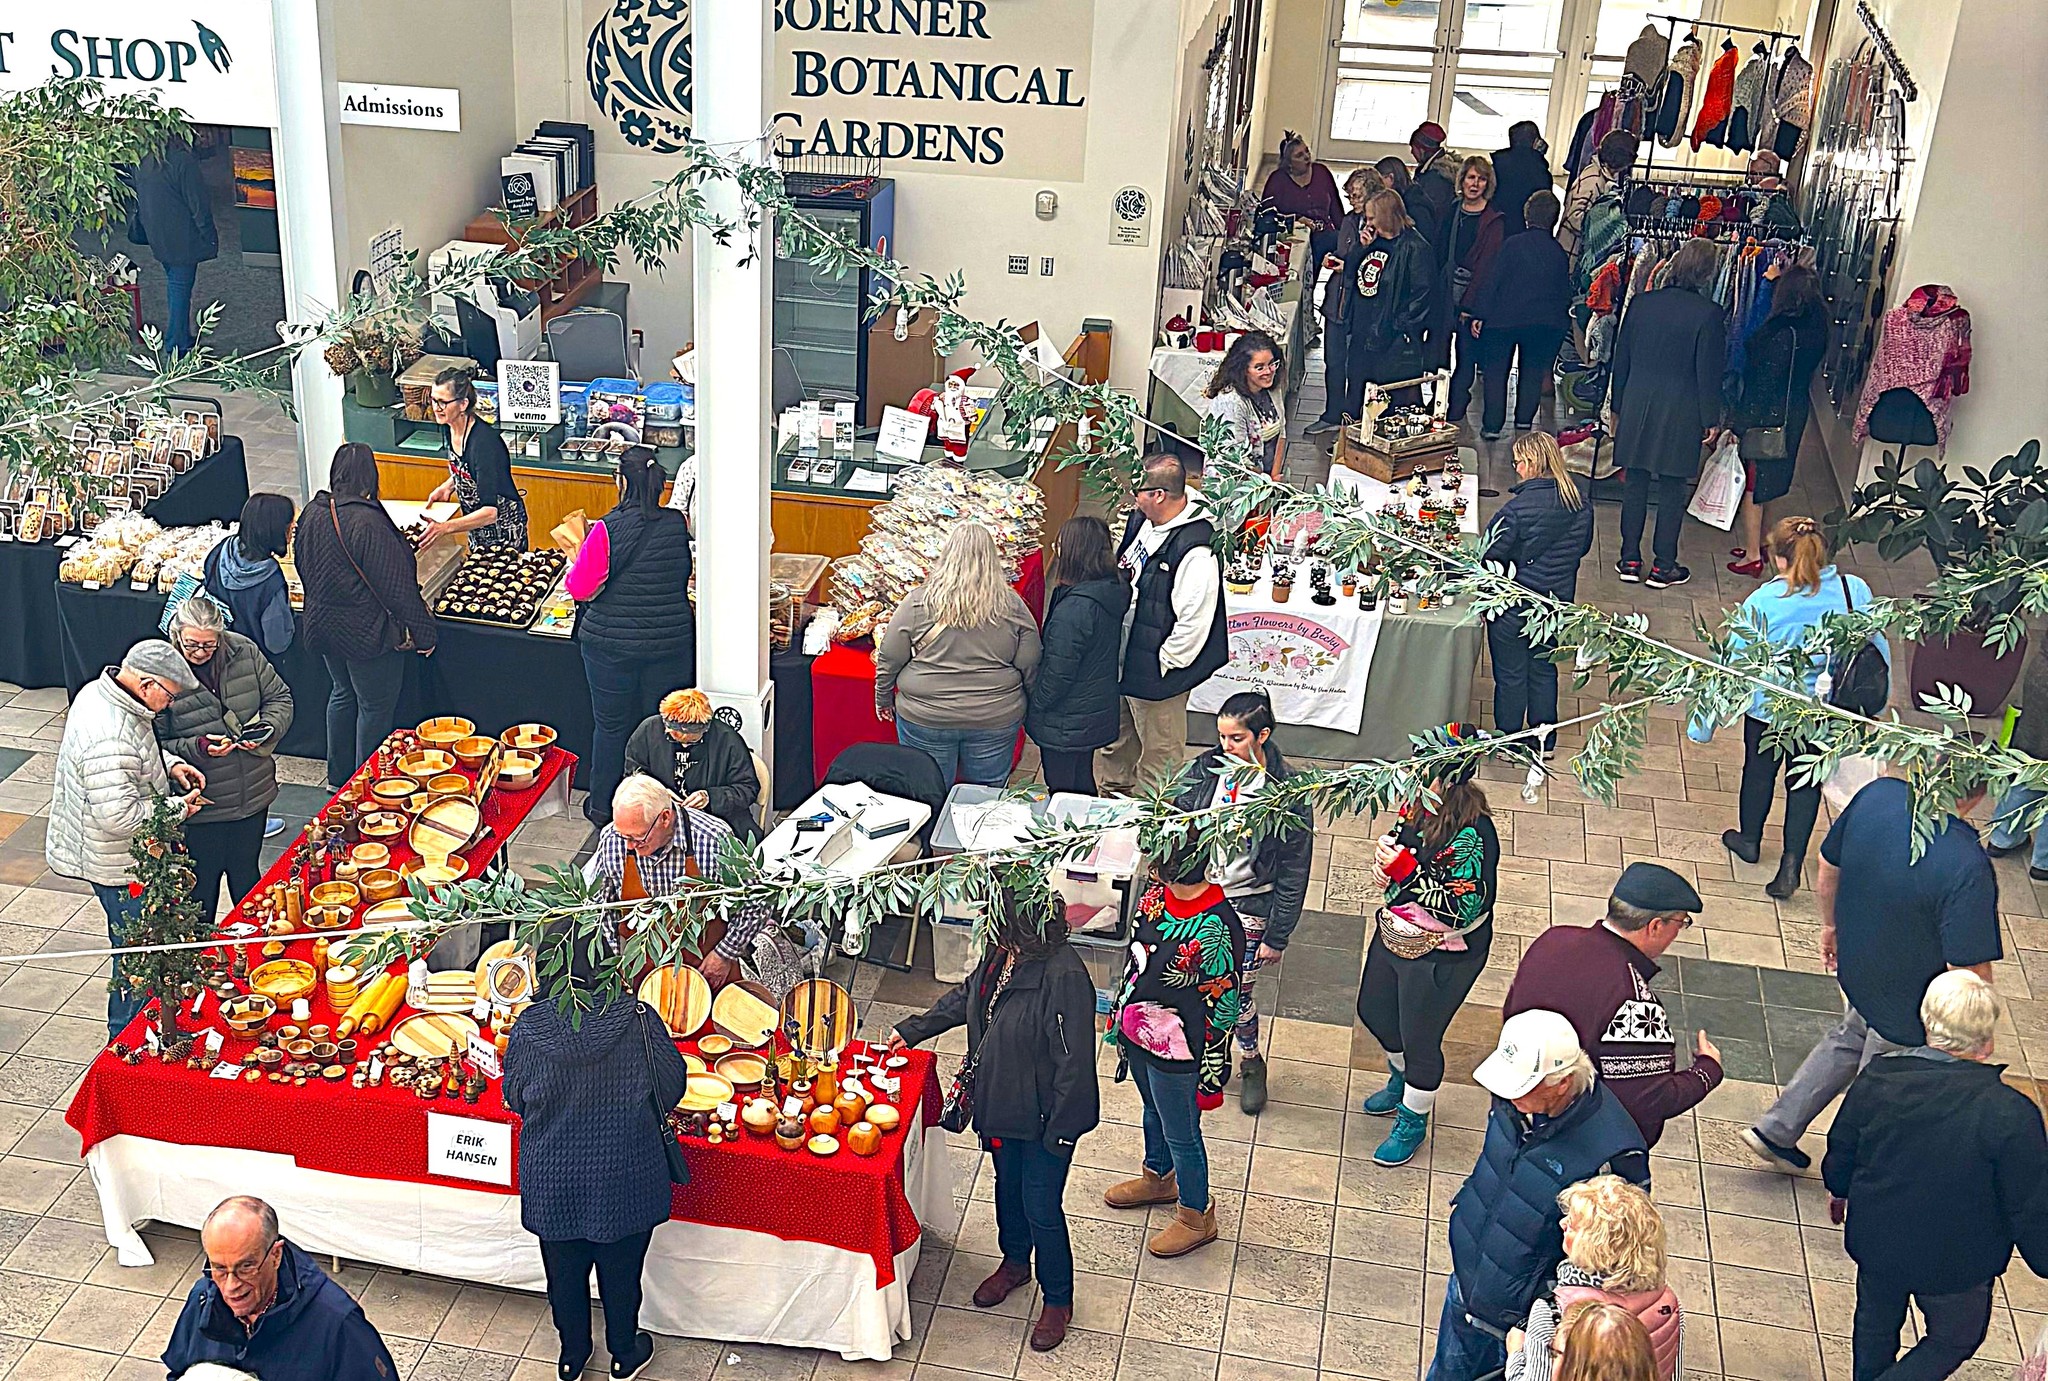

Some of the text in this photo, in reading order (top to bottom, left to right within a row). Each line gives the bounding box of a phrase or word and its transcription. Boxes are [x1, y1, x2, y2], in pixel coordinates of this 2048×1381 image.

[50, 28, 197, 83] SHOP
[791, 50, 1085, 107] BOTANICAL
[343, 94, 444, 118] Admissions
[773, 112, 1004, 165] GARDENS
[513, 412, 547, 421] venmo
[1252, 615, 1293, 630] Flowers
[1296, 622, 1310, 637] by
[1310, 627, 1341, 652] Becky
[456, 1134, 485, 1148] ERIK
[446, 1149, 498, 1166] HANSEN
